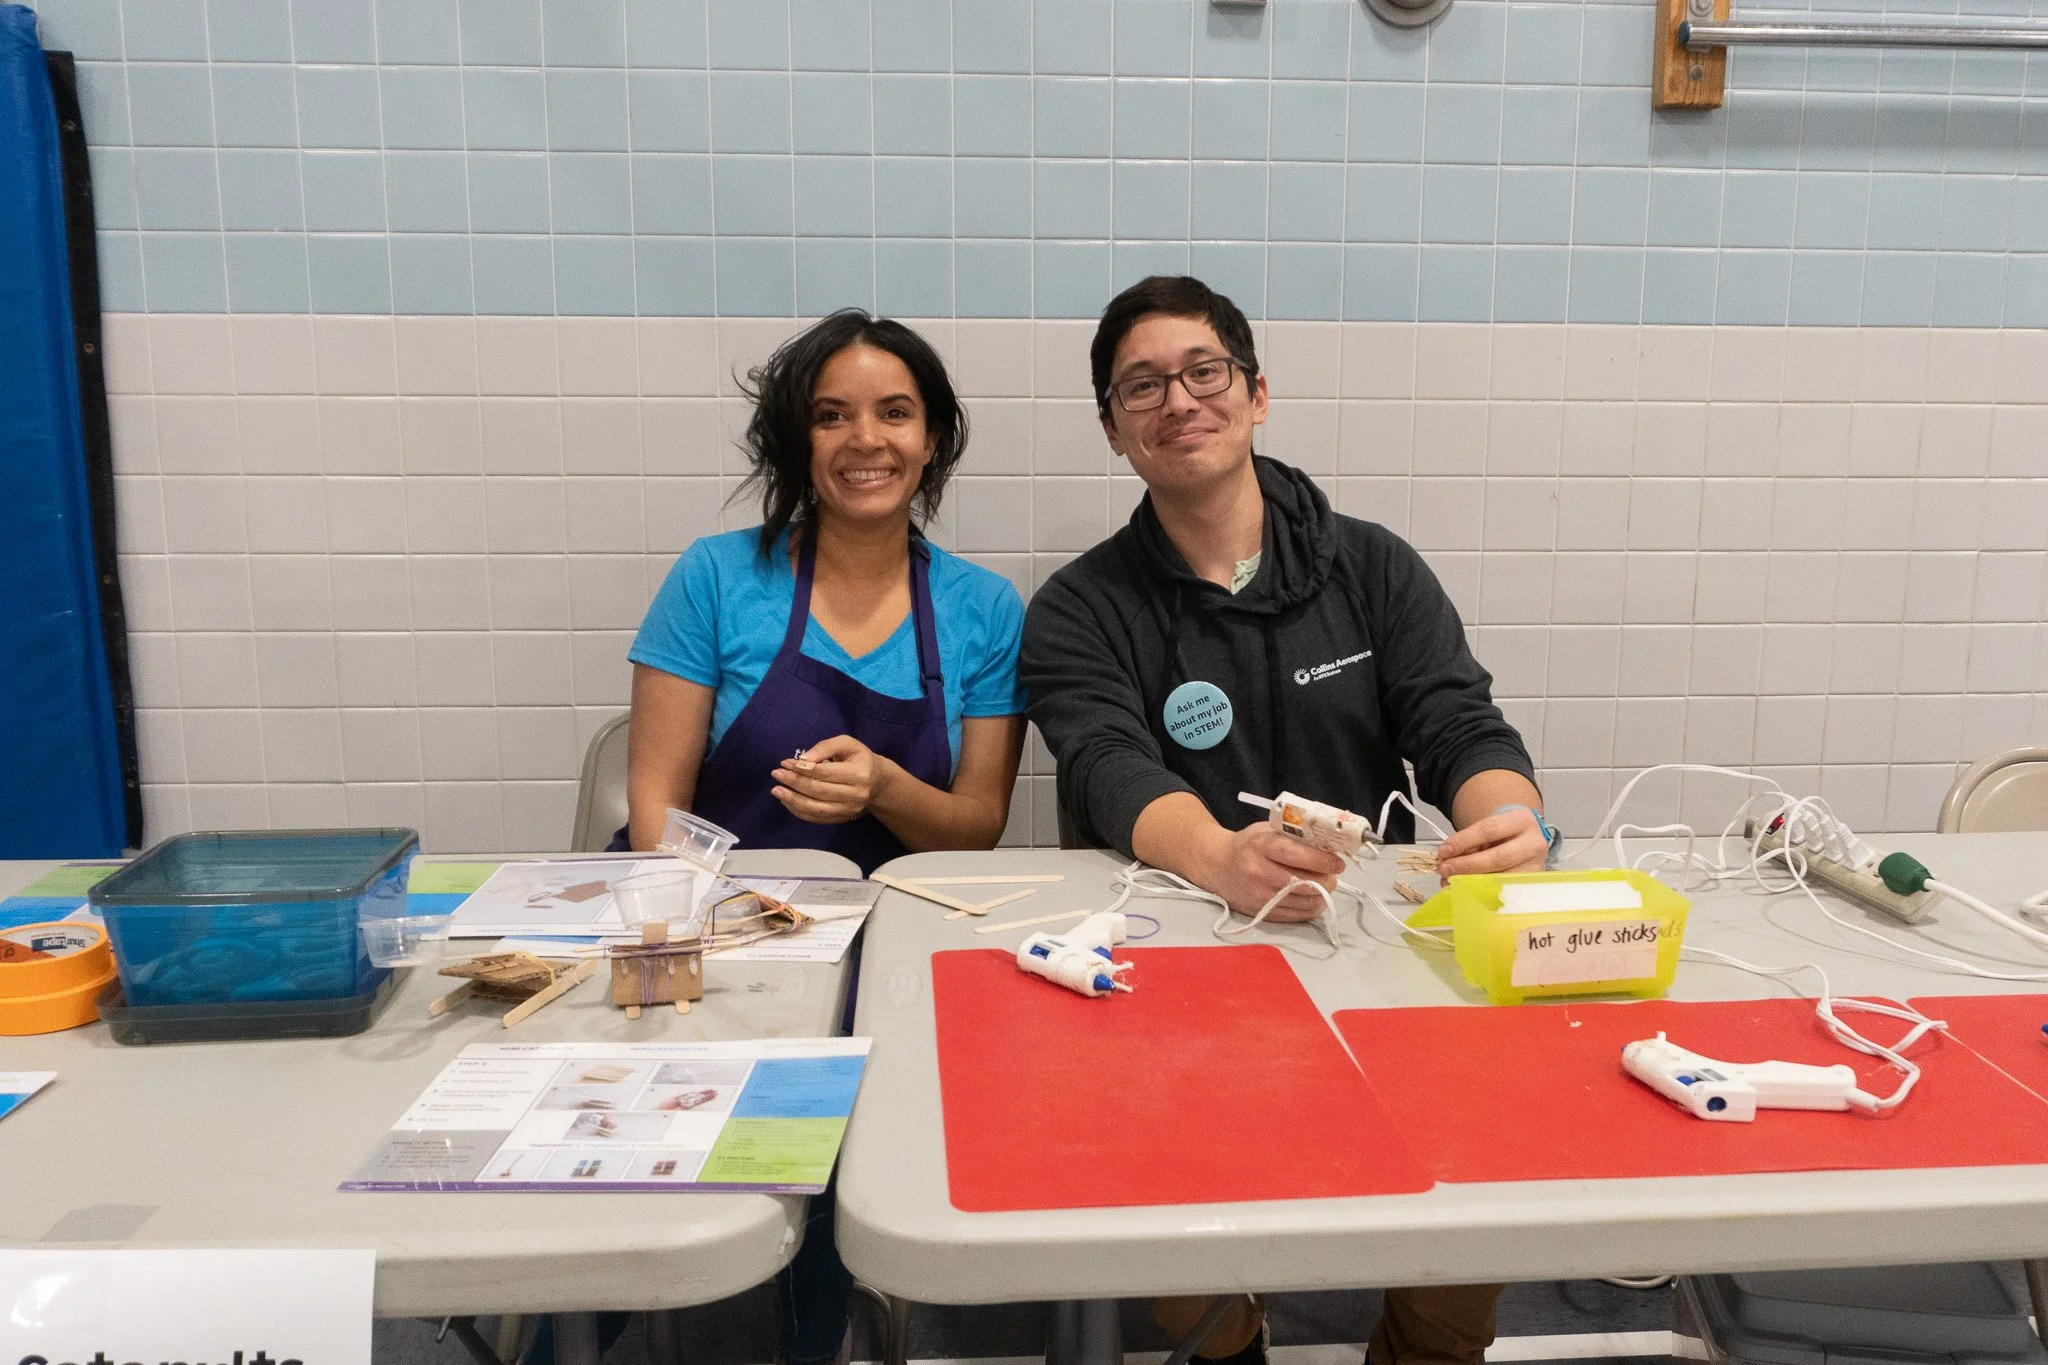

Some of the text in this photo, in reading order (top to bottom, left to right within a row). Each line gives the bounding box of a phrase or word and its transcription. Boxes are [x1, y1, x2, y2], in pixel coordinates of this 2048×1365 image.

[1310, 662, 1336, 676] Collins
[1336, 650, 1373, 668] Aerospace
[1169, 701, 1228, 732] about my job
[1177, 695, 1210, 714] Ask me
[1183, 717, 1224, 740] in STEM!
[1529, 931, 1555, 950] hot
[1566, 929, 1602, 953] glue
[1612, 923, 1657, 943] sticks
